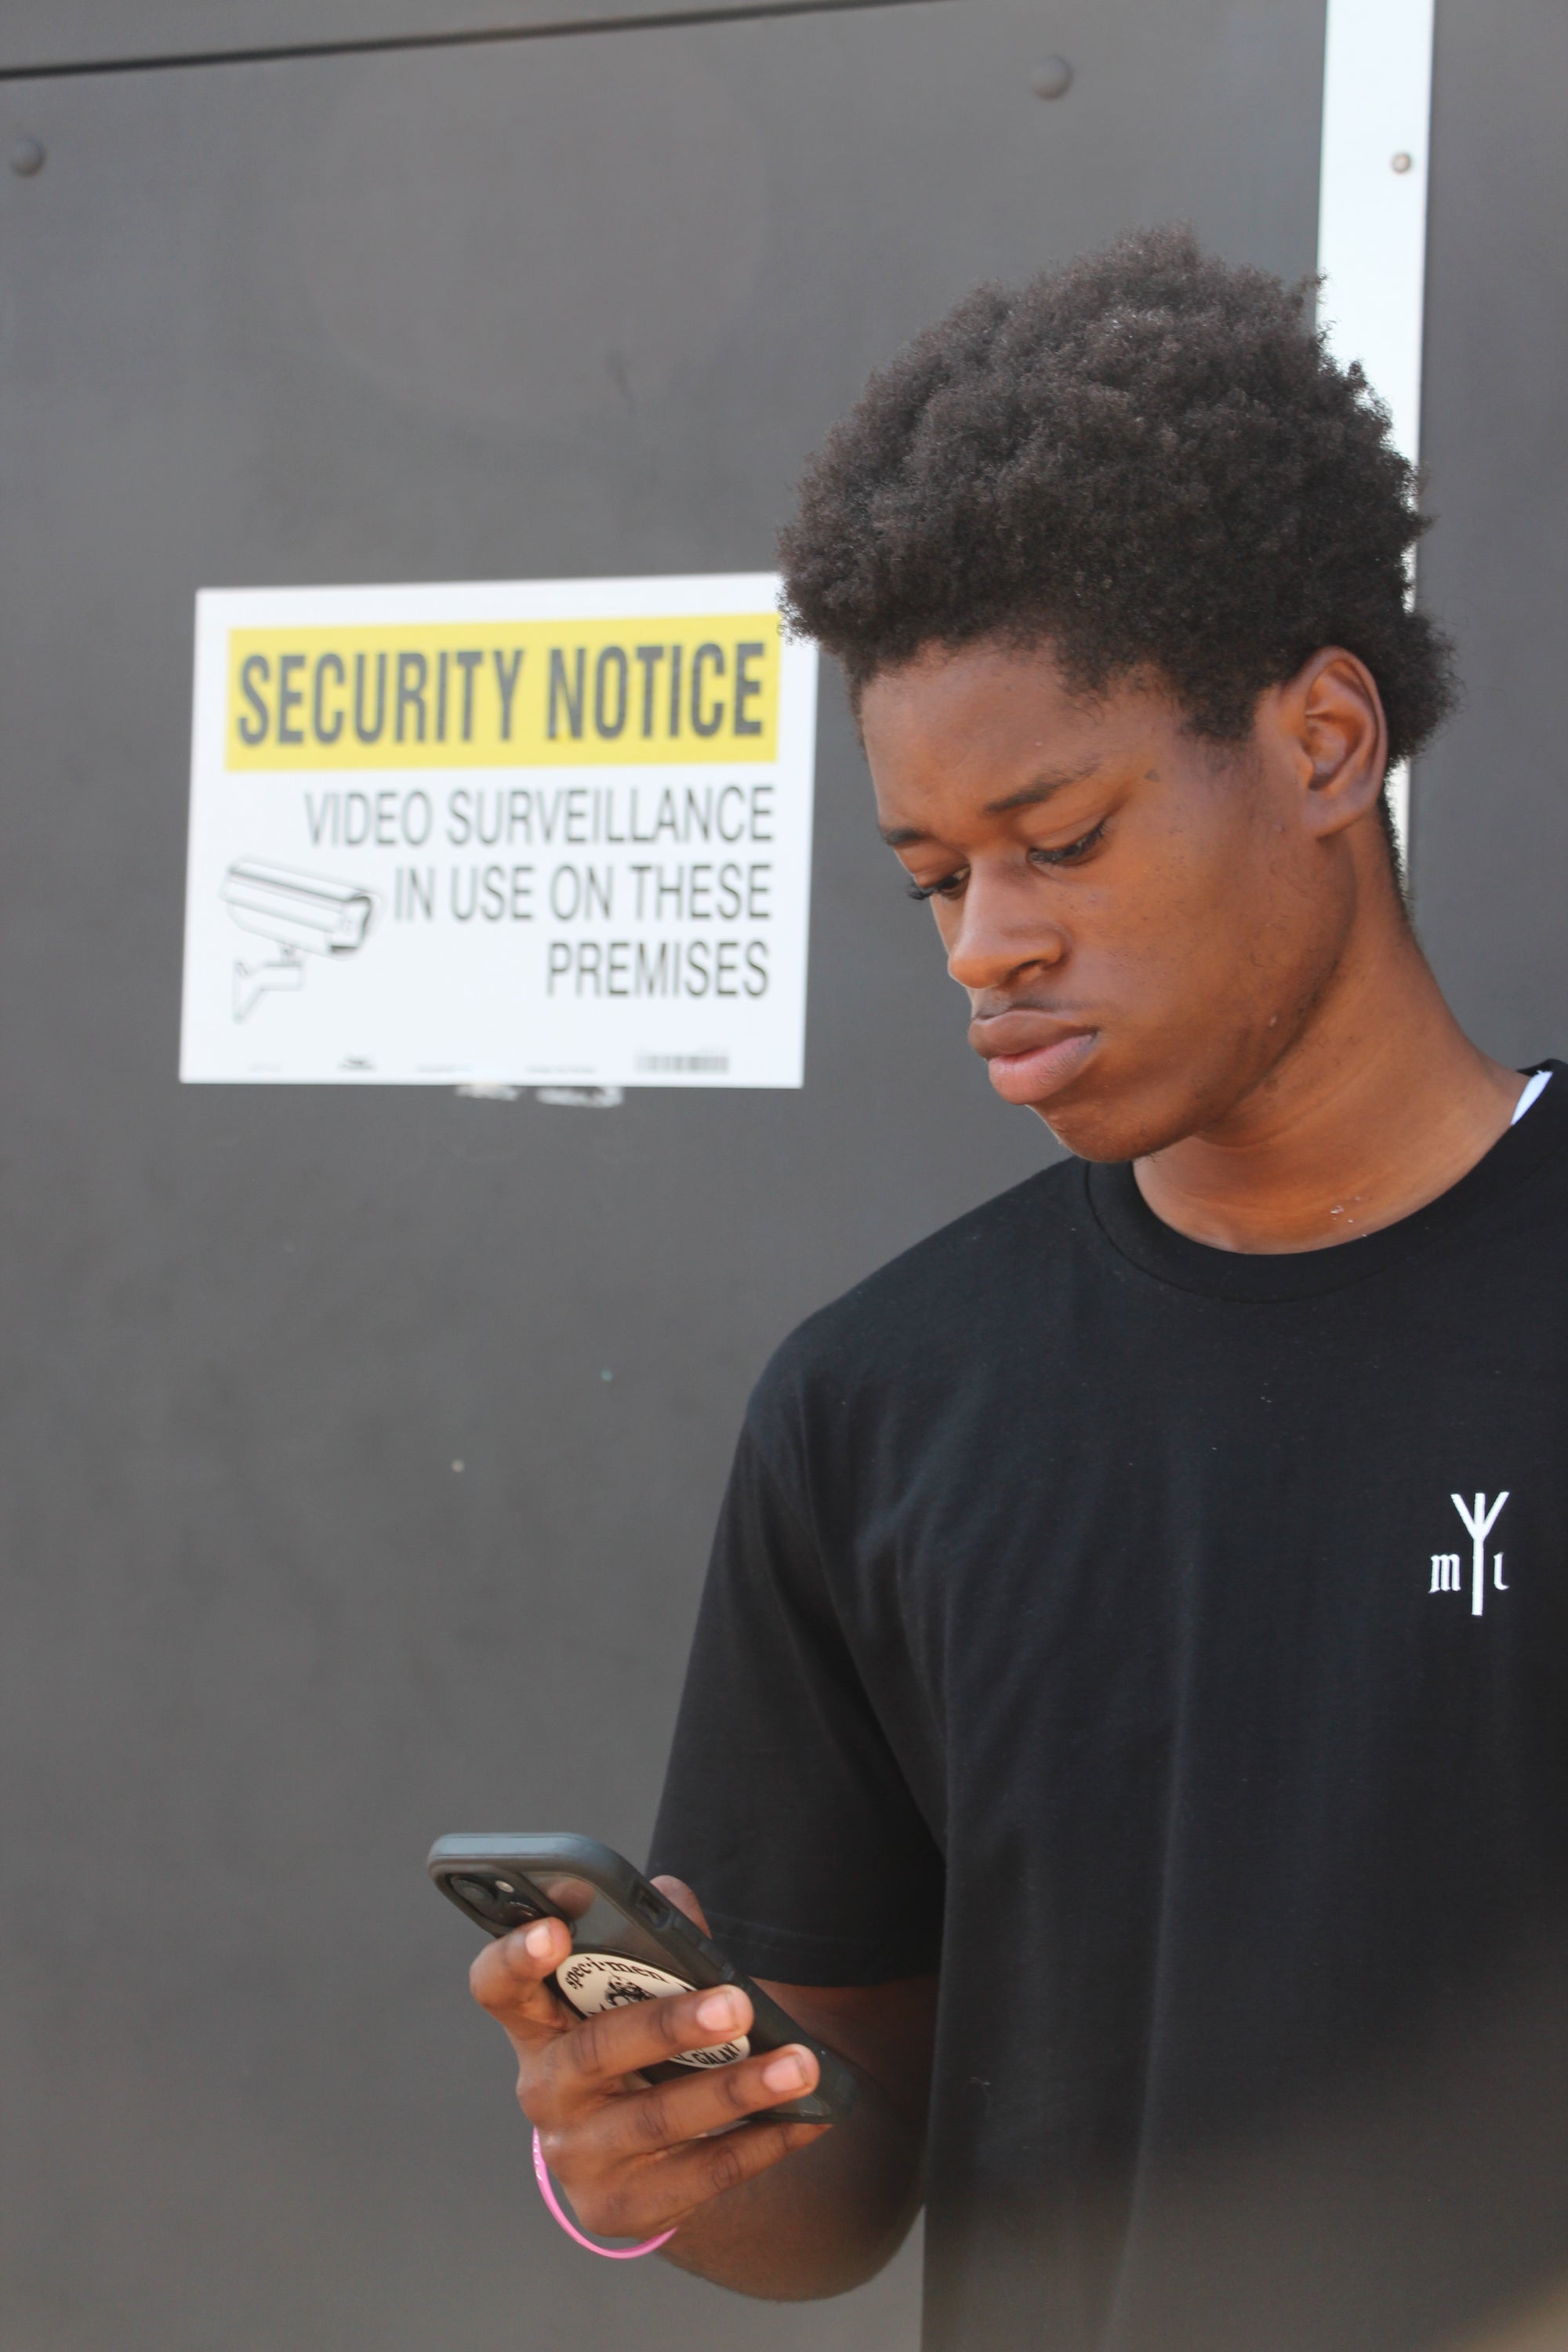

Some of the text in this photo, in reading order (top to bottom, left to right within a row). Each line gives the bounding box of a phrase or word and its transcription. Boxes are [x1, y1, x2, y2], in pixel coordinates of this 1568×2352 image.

[238, 641, 766, 746] SECURITY NOTICE
[305, 784, 775, 848] VIDEO SURVEILLANCE
[394, 861, 773, 924] IN USE ON THESE
[546, 938, 770, 1000] PREMISES
[691, 2042, 741, 2064] GALAXY
